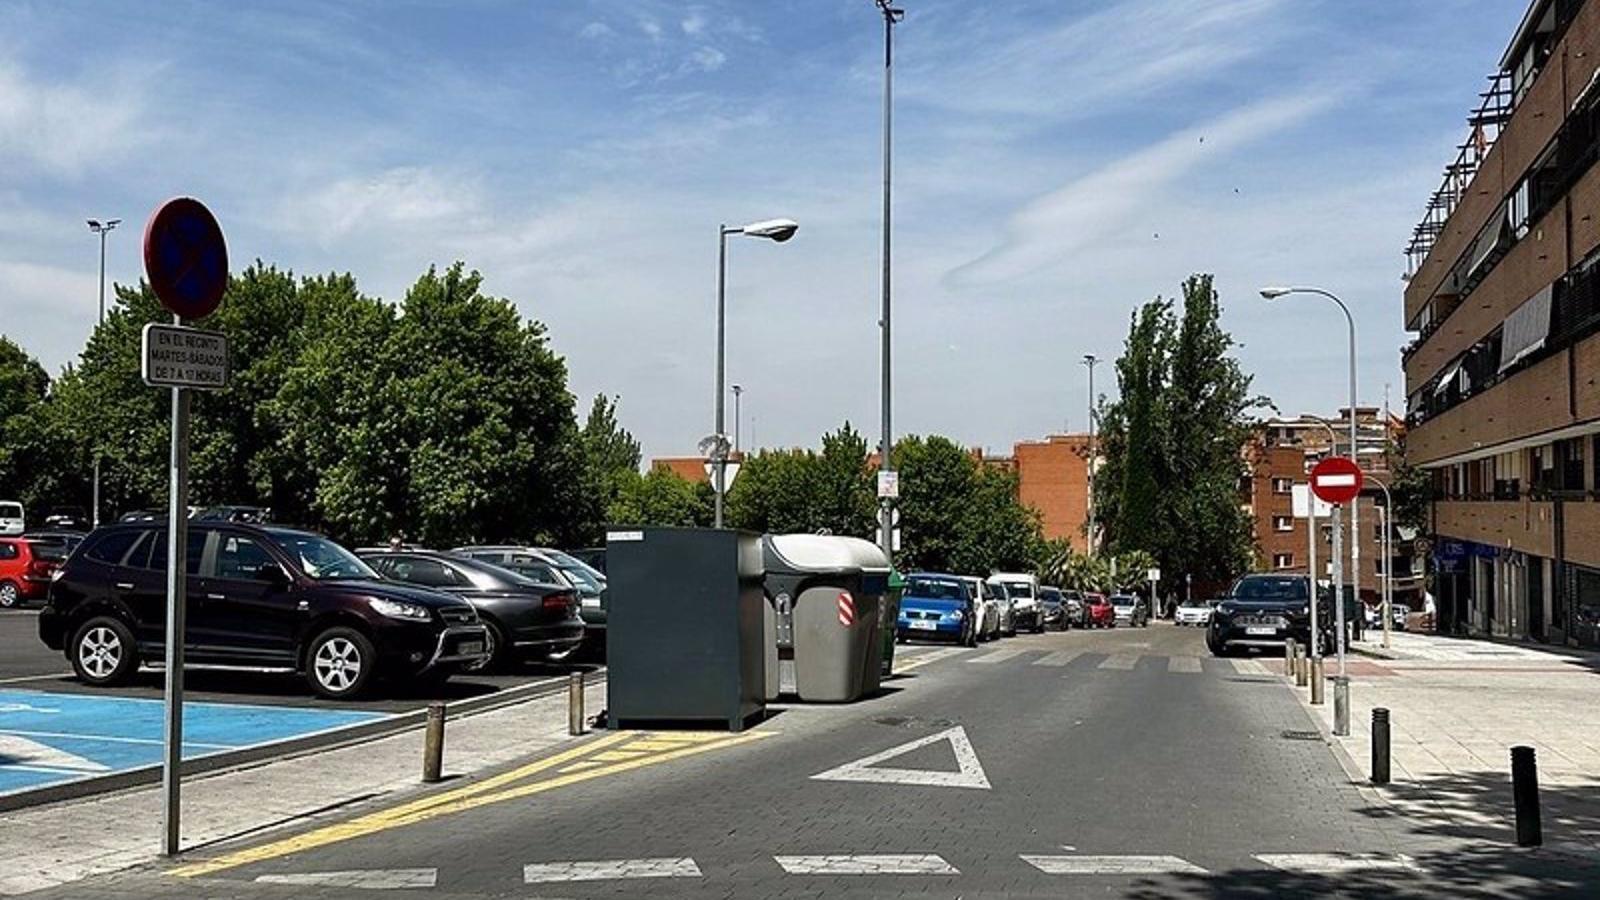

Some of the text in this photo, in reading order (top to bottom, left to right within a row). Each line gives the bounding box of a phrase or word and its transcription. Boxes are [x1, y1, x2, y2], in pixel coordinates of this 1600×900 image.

[159, 332, 218, 350] EN EL RECINTO
[156, 367, 167, 378] DE
[176, 368, 185, 379] A
[196, 370, 222, 382] HORAS
